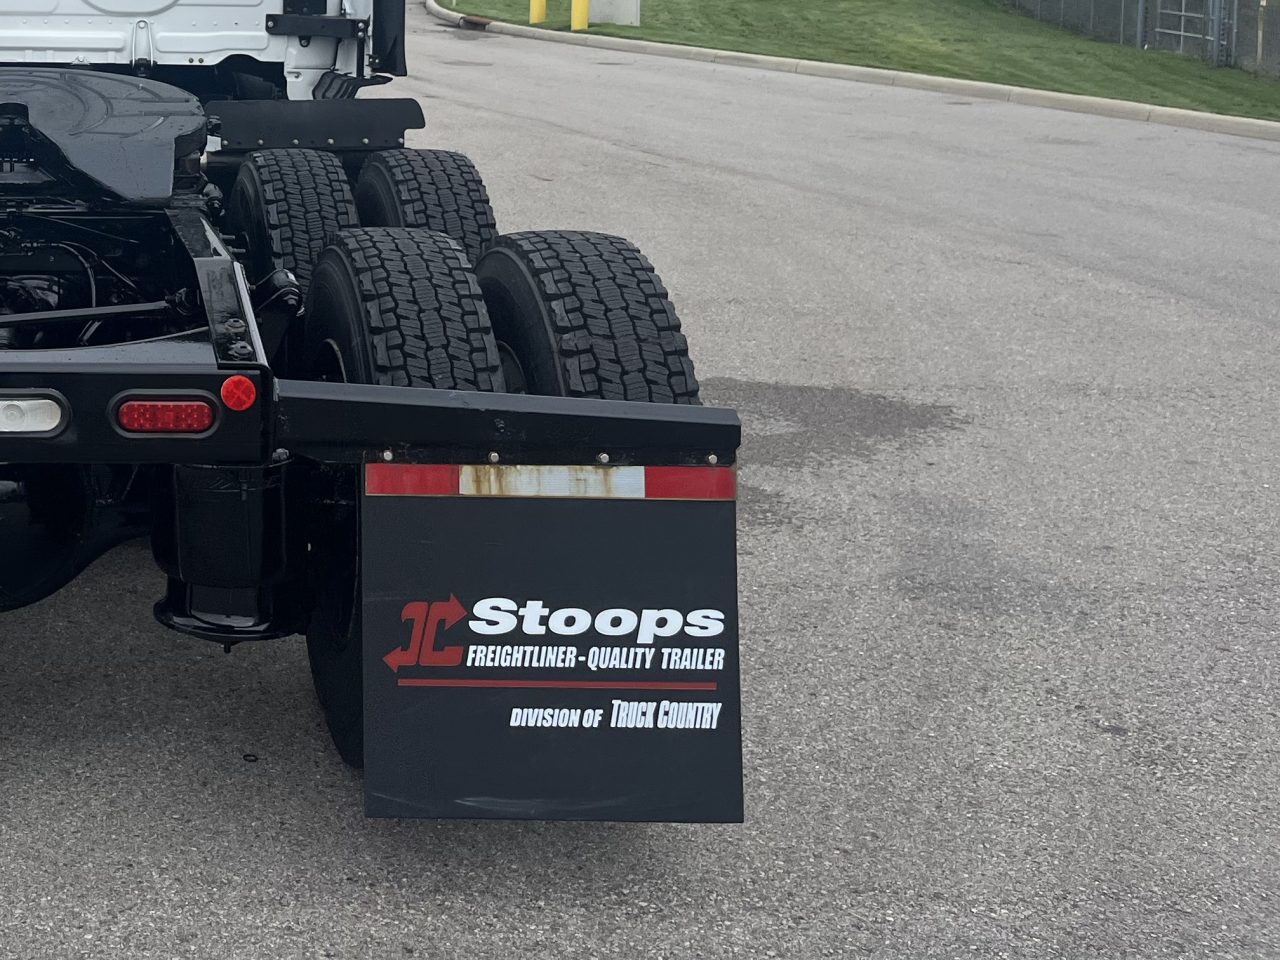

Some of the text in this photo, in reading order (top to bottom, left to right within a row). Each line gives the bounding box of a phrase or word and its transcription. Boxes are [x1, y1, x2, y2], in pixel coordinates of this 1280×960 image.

[469, 597, 724, 644] Stoops
[661, 647, 725, 670] TRAILER
[509, 700, 723, 729] DIVISION OF TRUCK COUNTRY
